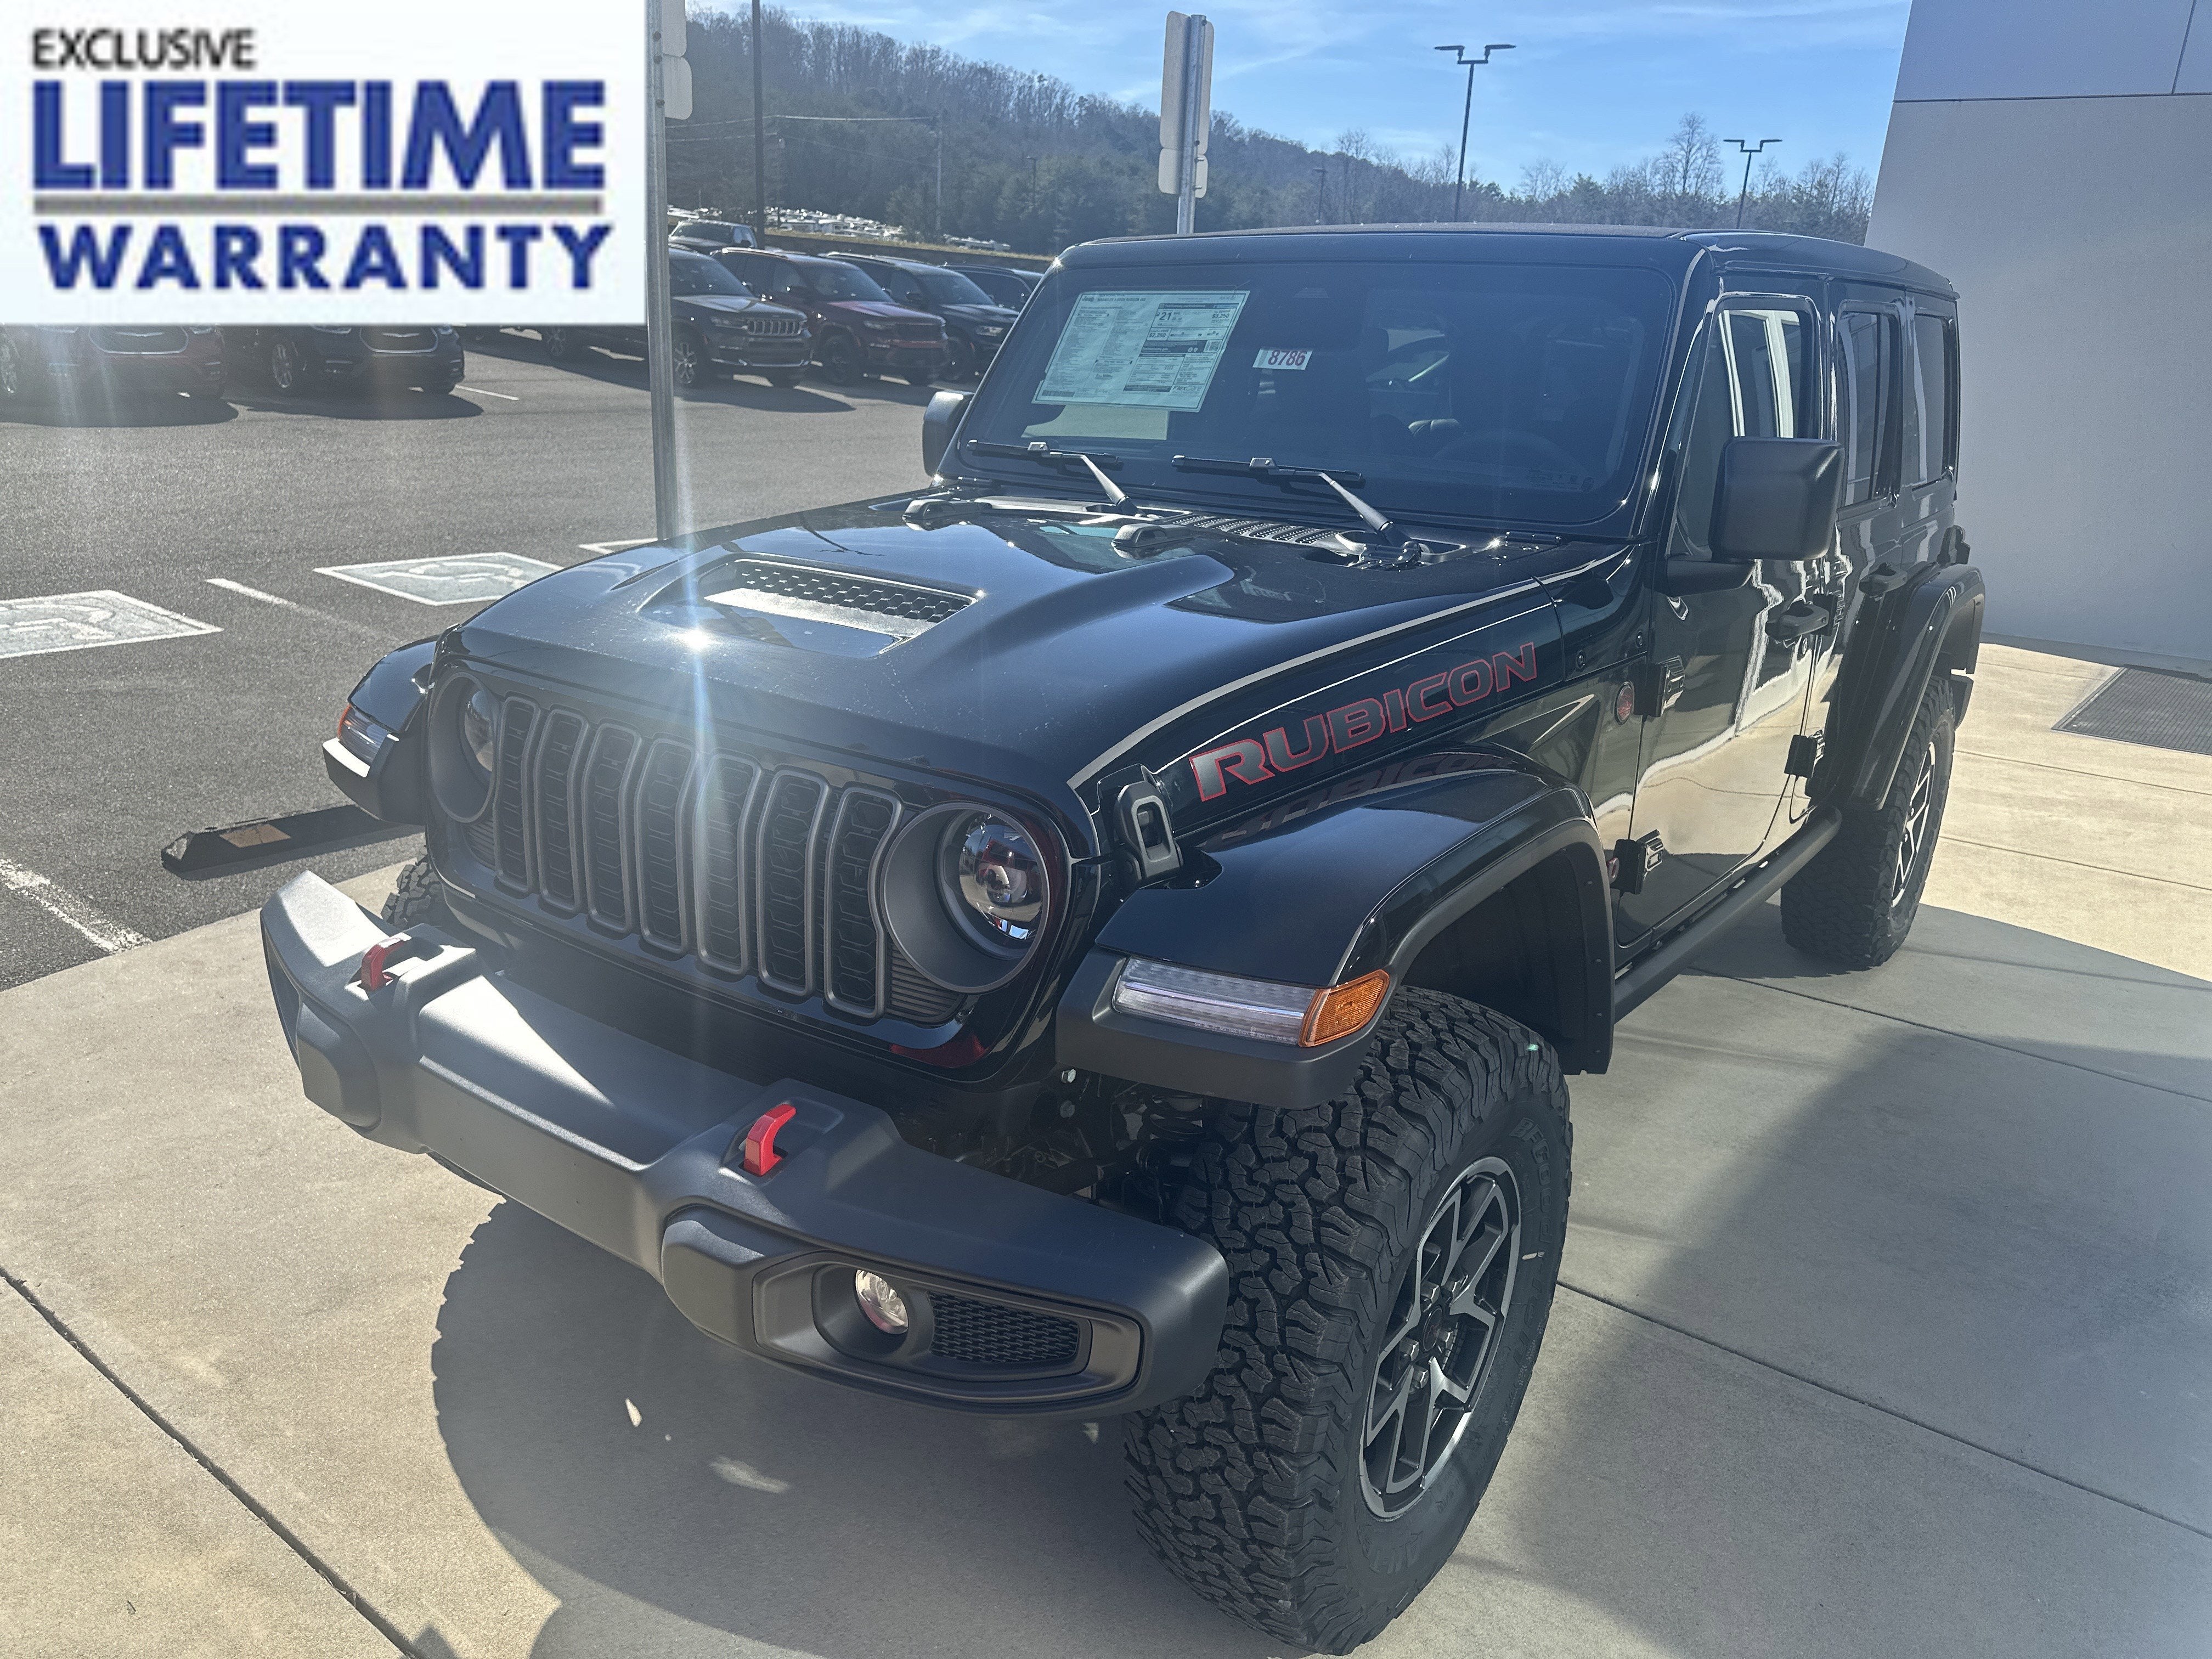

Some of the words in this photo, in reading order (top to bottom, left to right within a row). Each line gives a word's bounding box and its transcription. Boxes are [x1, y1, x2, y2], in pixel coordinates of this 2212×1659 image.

[1159, 312, 1172, 321] 21
[1268, 349, 1307, 366] 8786
[1188, 641, 1537, 803] RUBICON
